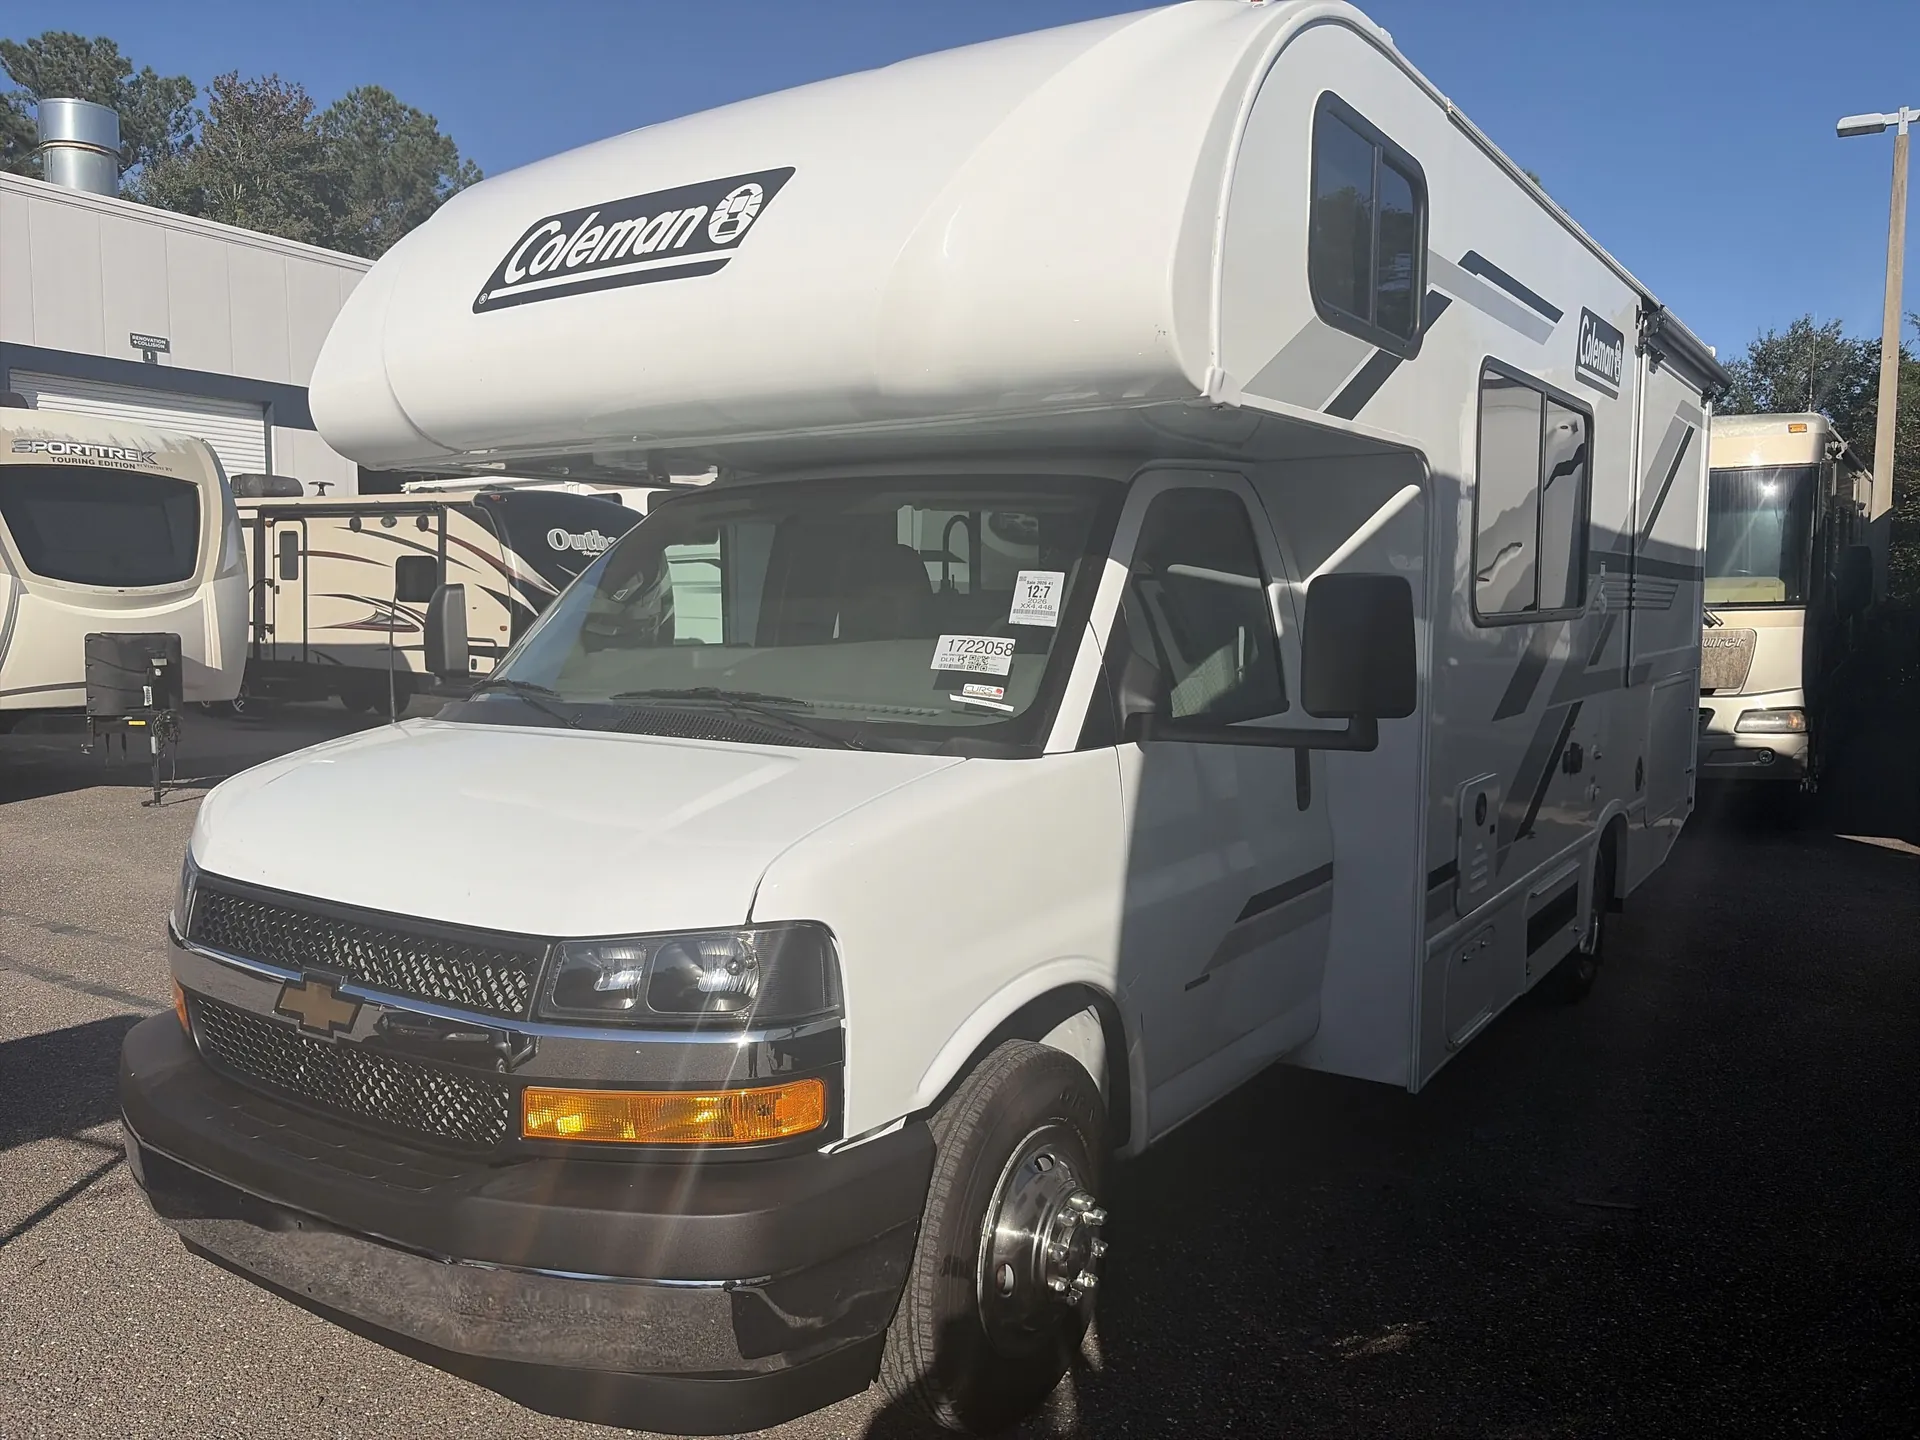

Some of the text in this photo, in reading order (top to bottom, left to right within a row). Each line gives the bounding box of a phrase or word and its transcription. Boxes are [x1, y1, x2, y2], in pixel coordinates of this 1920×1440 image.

[503, 204, 709, 285] Coleman
[131, 334, 166, 345] RENOVATION
[1579, 314, 1615, 378] Coleman
[146, 351, 152, 360] 1
[11, 438, 158, 466] SPORTTREK
[50, 456, 137, 470] TOURING EDITION
[1027, 584, 1051, 599] 12:7
[948, 638, 1015, 657] 1722058
[1702, 637, 1747, 649] urer
